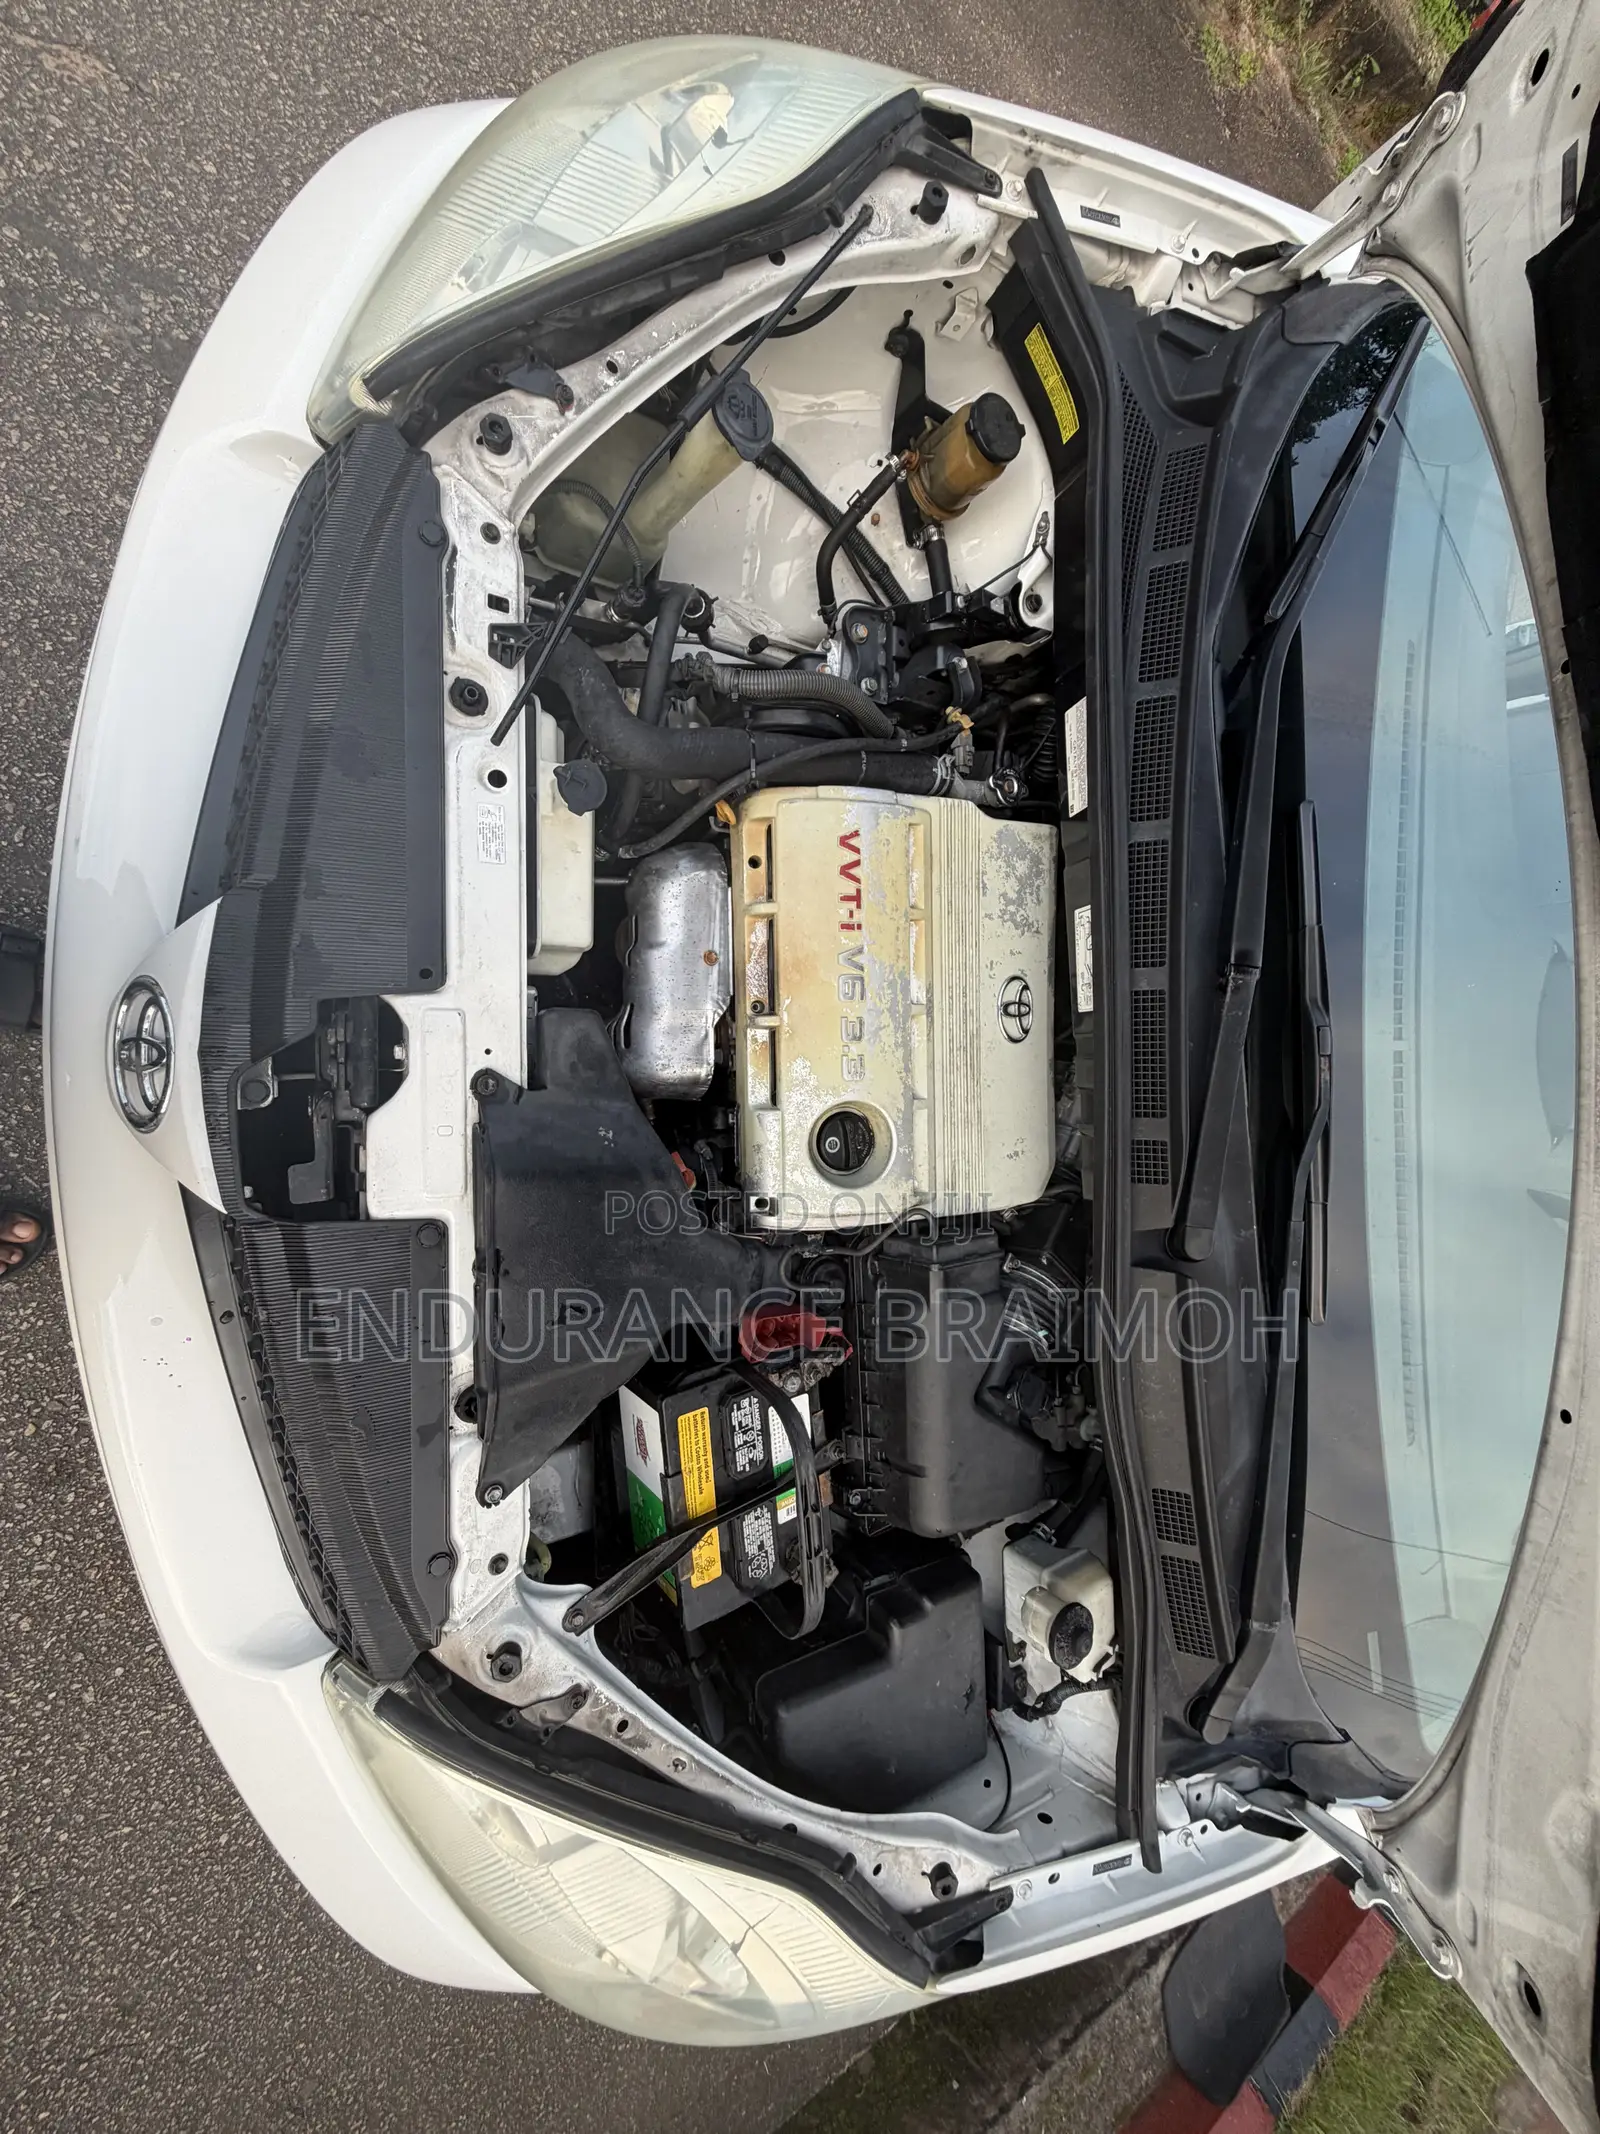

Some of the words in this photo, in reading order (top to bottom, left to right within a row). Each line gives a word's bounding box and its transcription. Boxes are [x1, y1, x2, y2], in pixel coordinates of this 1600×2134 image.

[838, 830, 862, 931] VVT-i
[838, 946, 865, 1001] V6
[841, 1015, 866, 1081] 3.3
[696, 1466, 704, 1495] Wholesale
